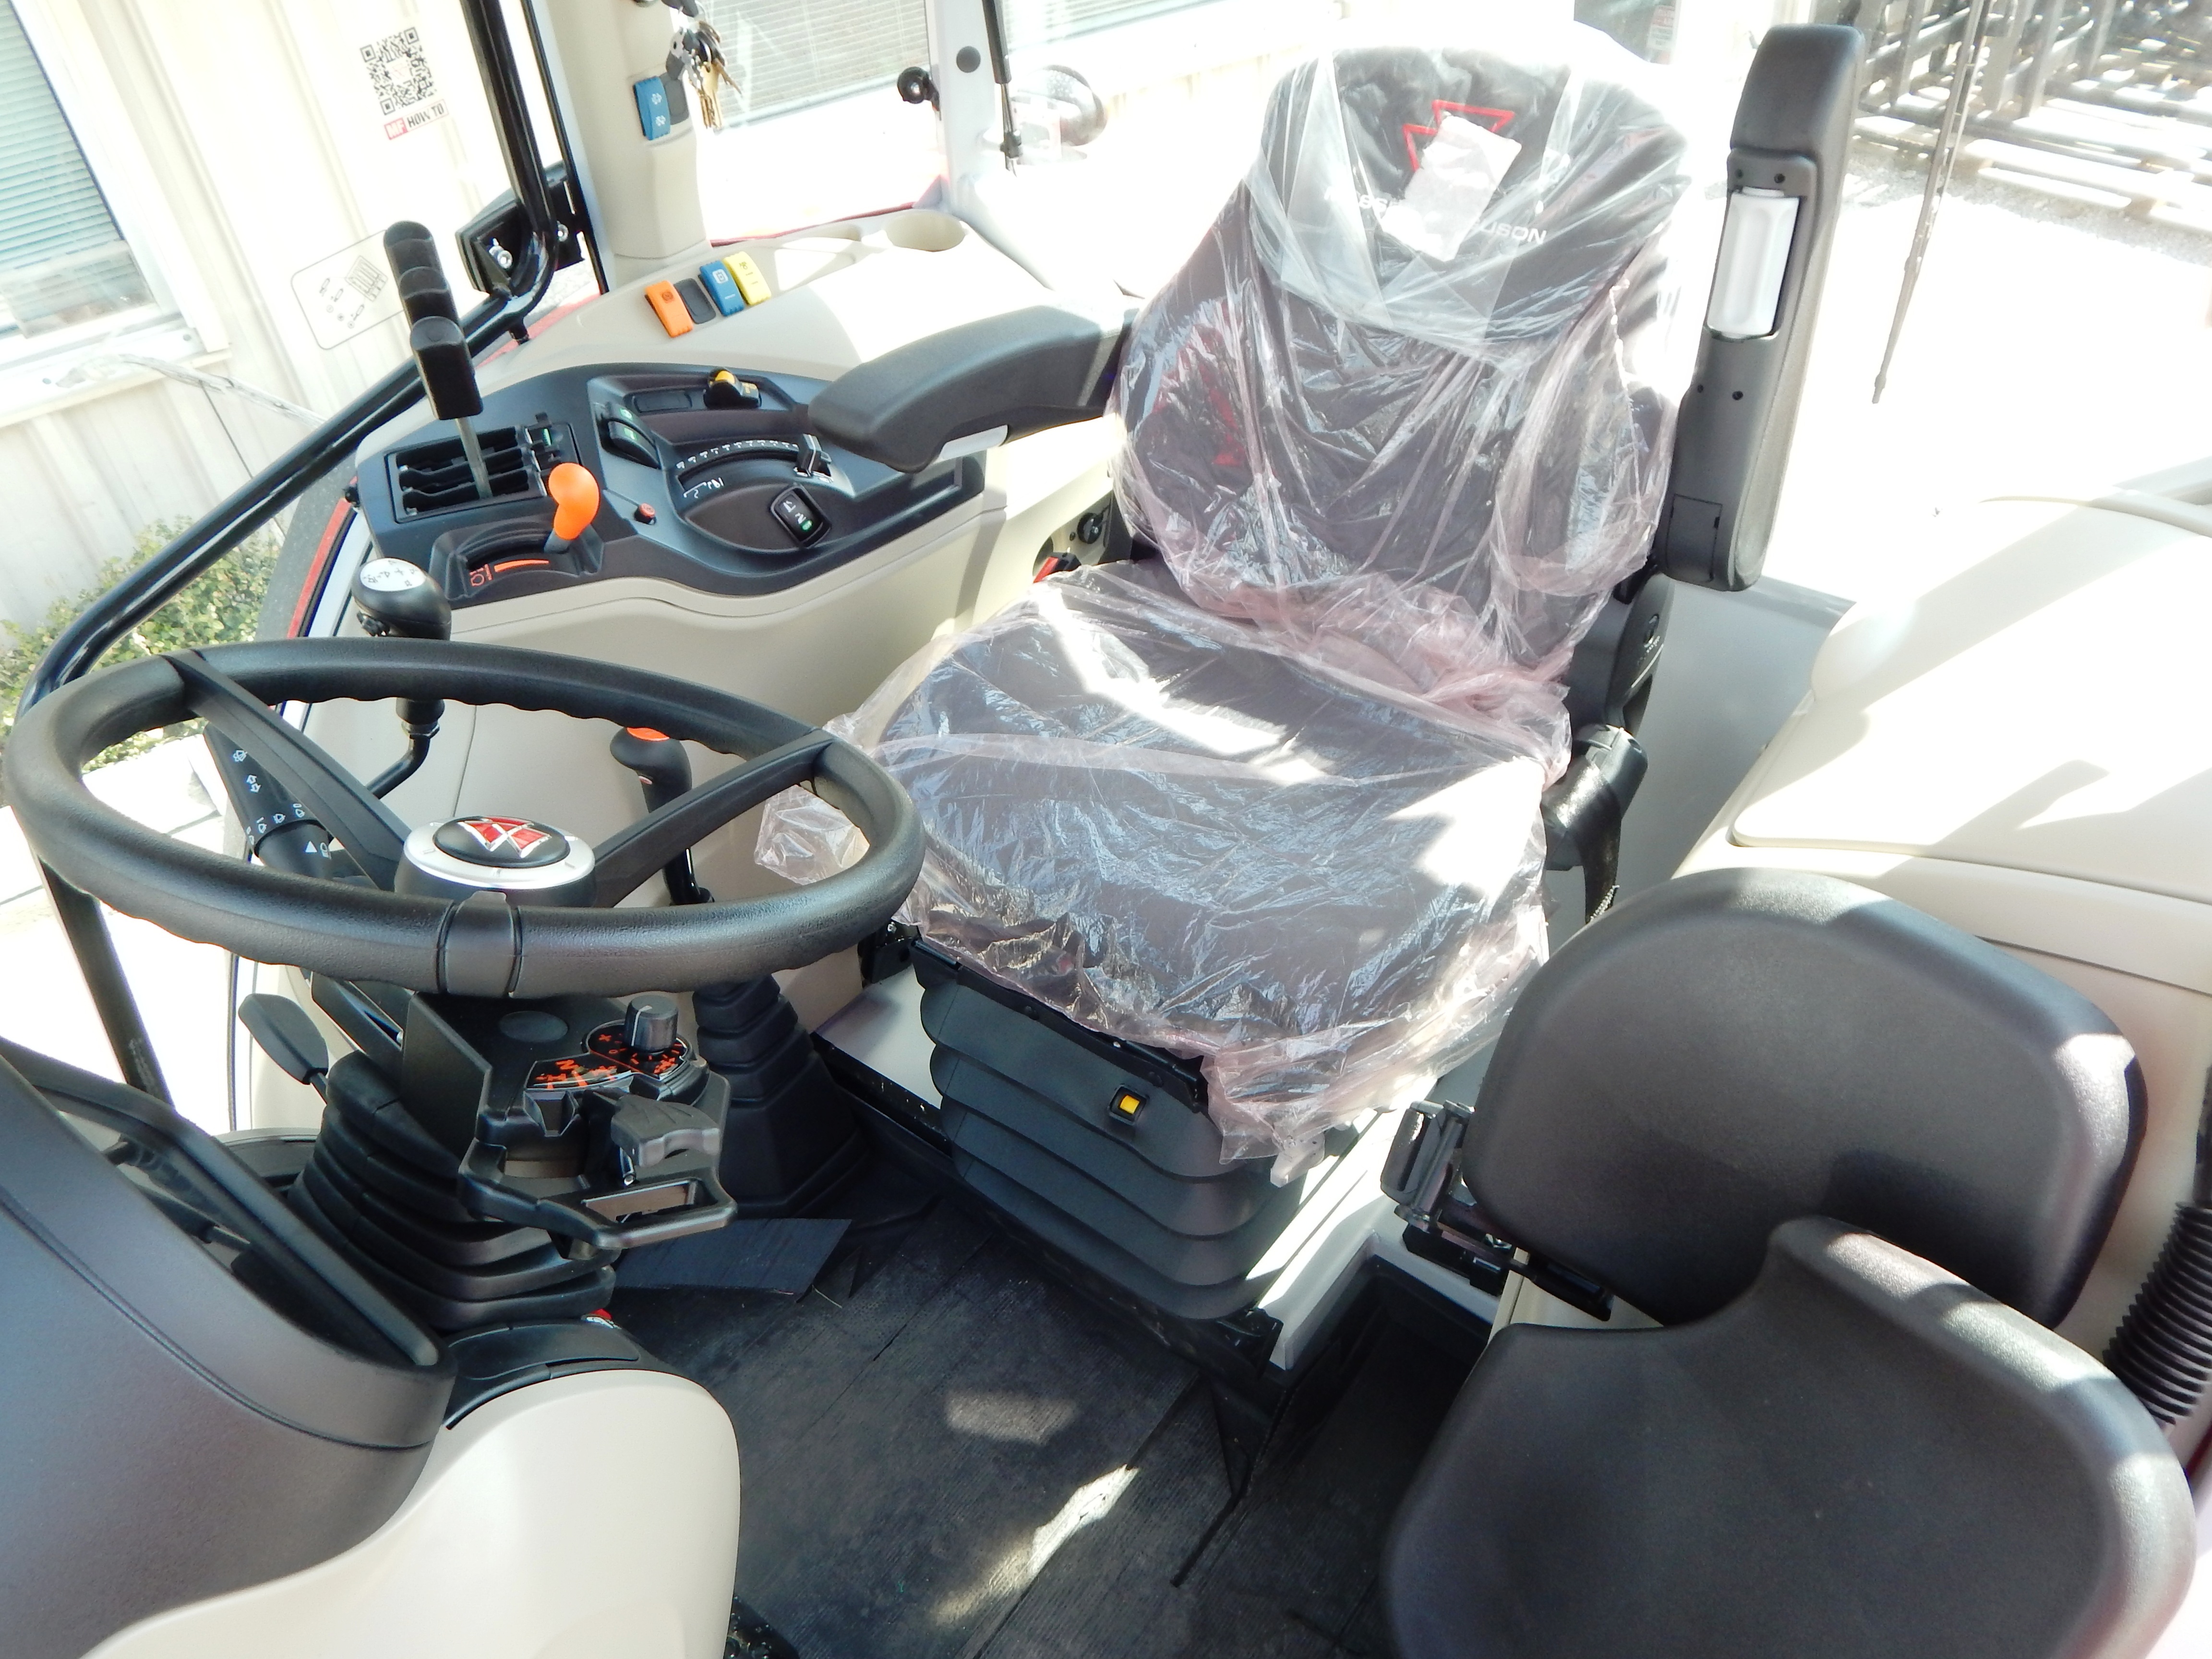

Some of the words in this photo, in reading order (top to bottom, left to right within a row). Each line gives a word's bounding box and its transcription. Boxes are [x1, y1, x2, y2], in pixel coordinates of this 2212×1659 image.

[385, 119, 405, 138] MF
[407, 108, 431, 128] HOW
[431, 103, 444, 117] TO
